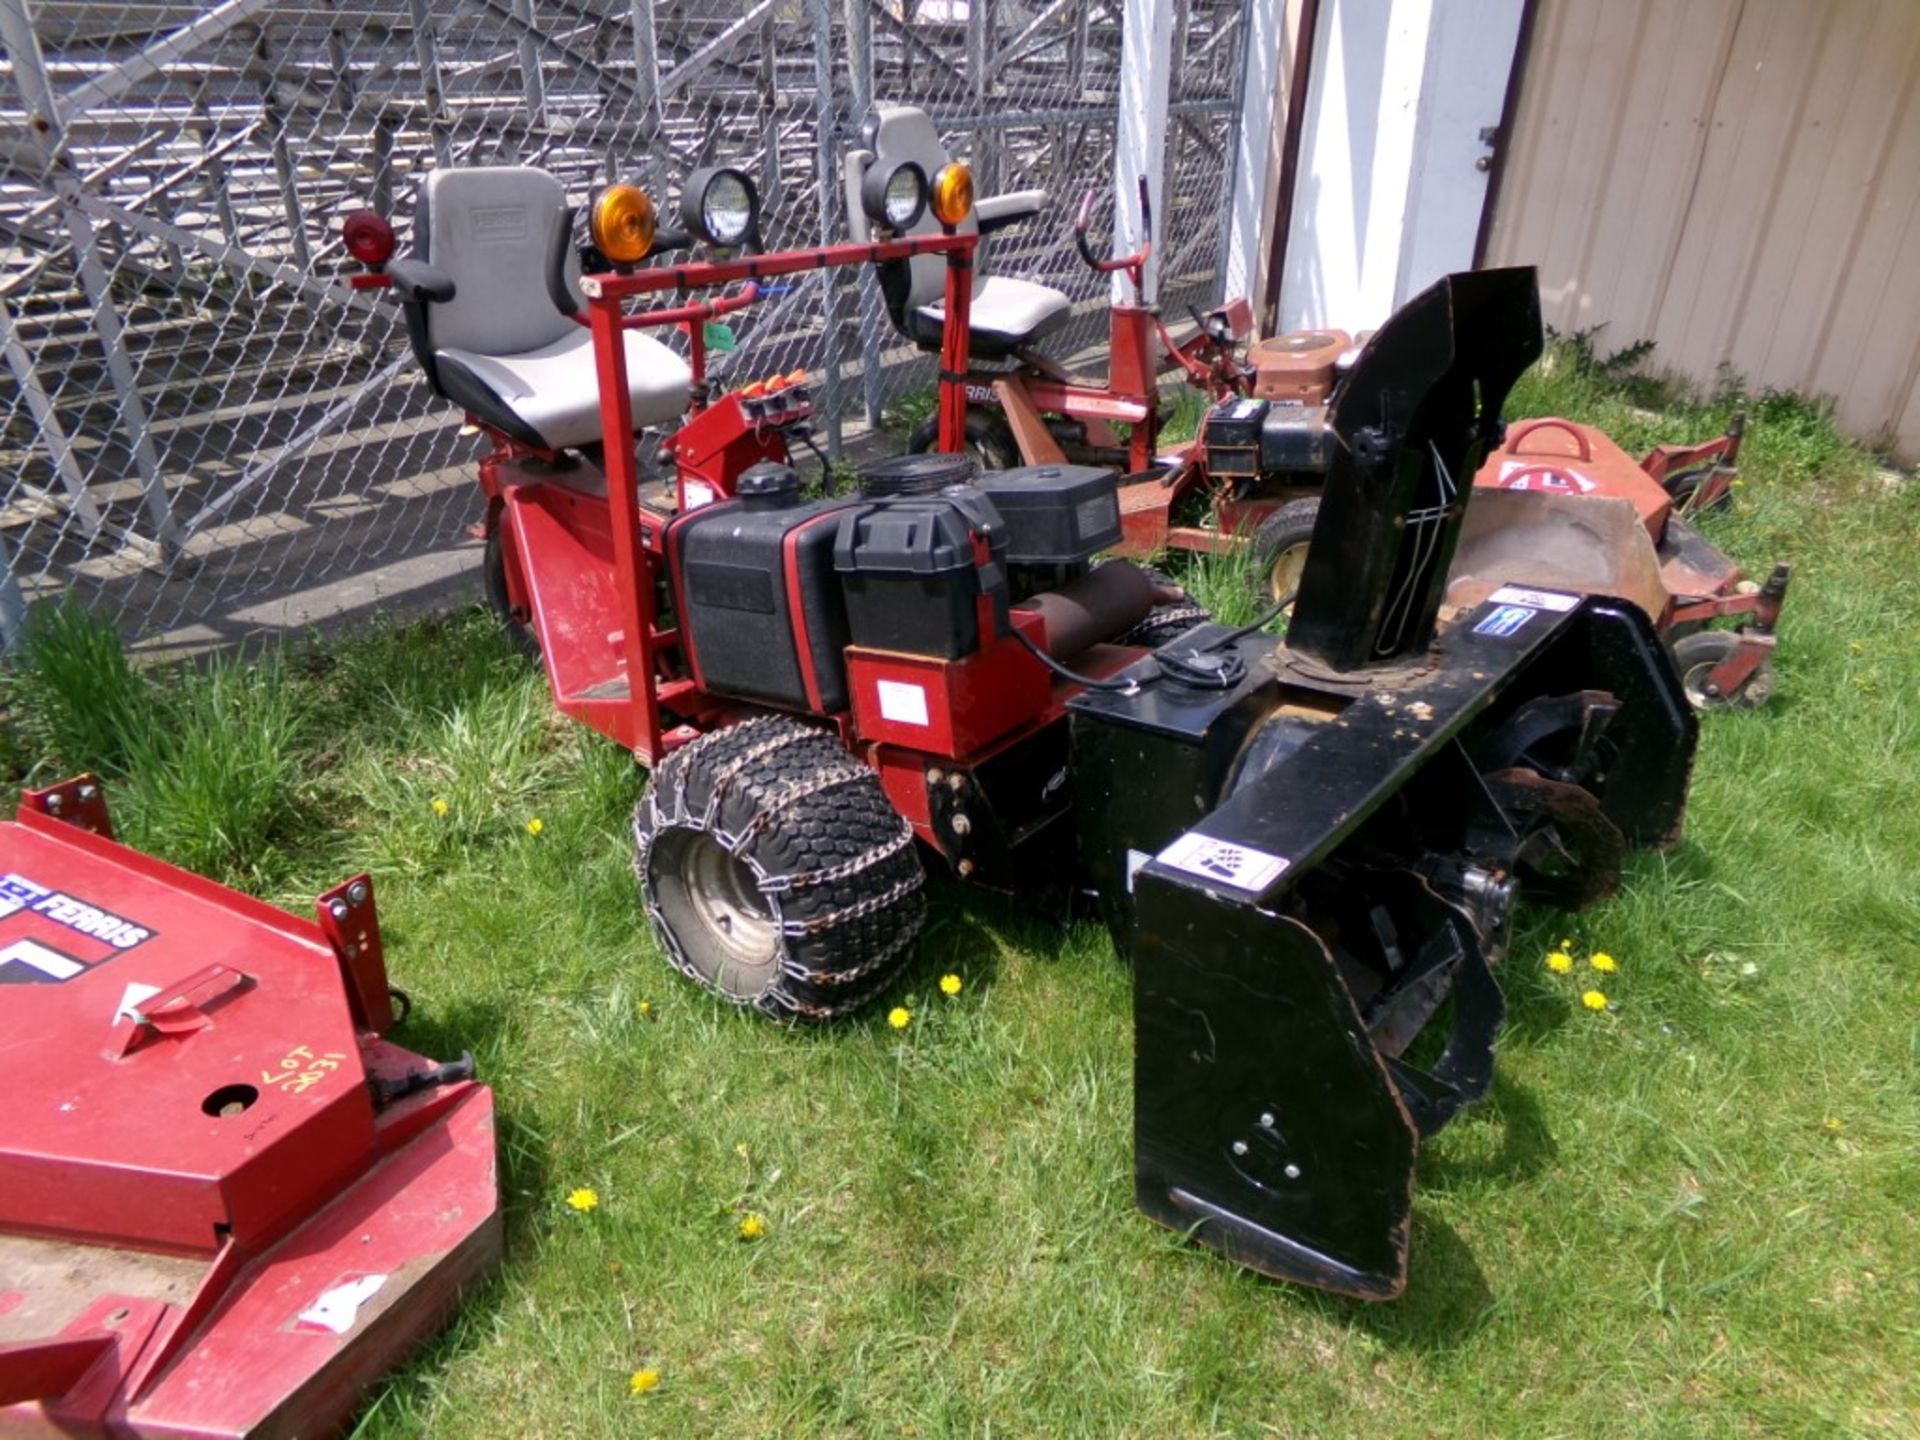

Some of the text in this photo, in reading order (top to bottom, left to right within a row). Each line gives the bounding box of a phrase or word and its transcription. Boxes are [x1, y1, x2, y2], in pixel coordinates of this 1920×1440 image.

[965, 385, 1002, 402] RRIS
[31, 892, 150, 949] FERRIS
[261, 1045, 314, 1085] LOT
